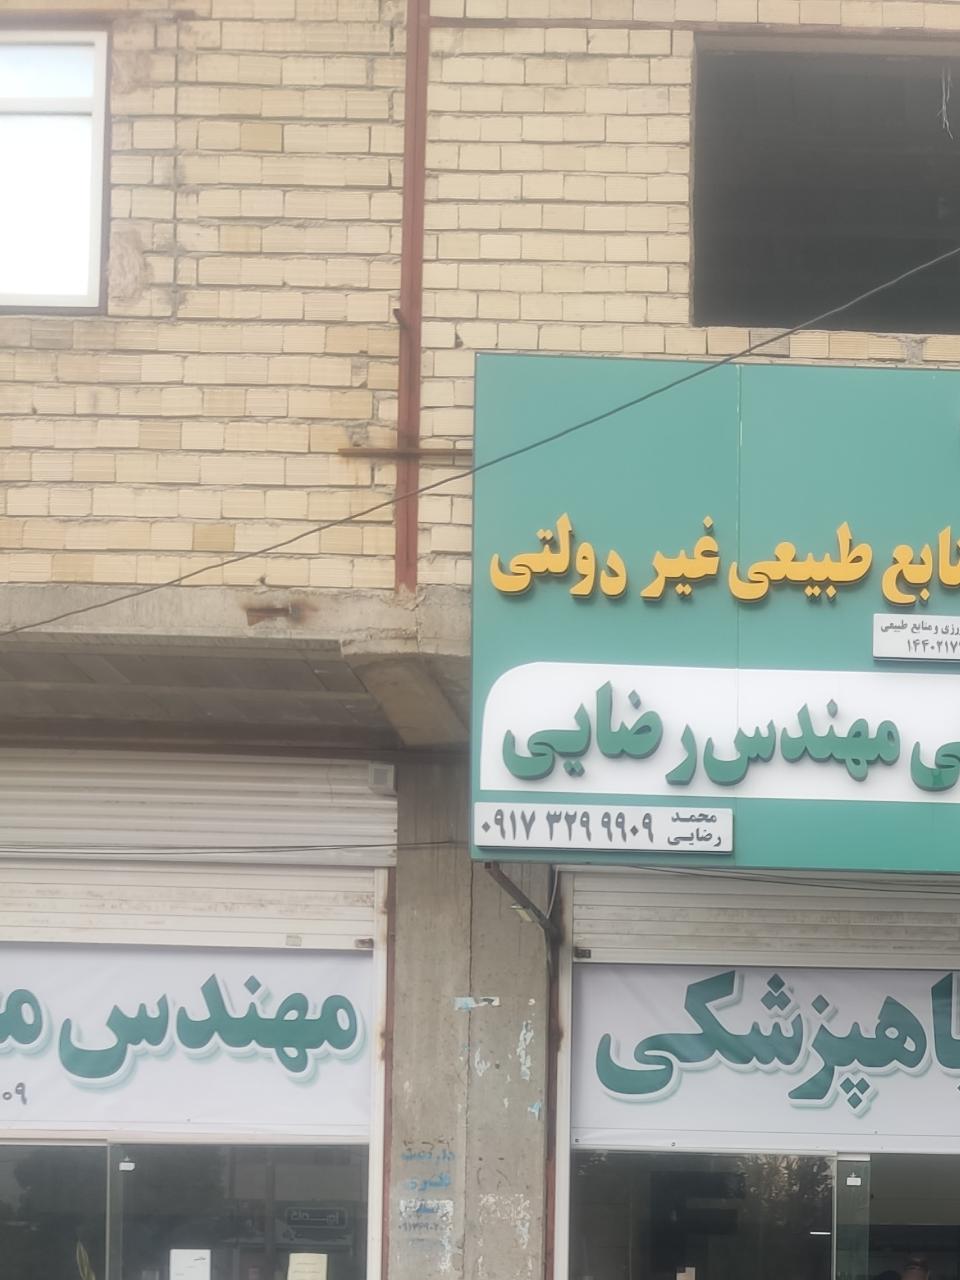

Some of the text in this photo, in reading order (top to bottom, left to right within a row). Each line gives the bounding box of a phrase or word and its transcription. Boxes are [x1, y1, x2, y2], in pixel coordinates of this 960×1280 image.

[489, 513, 628, 598] دولتی
[641, 516, 721, 600] غیر
[728, 522, 873, 602] طبیعی
[880, 620, 908, 633] طبیعی
[910, 622, 933, 635] منابع
[501, 681, 697, 786] رضایی
[702, 699, 901, 786] مهندس
[481, 808, 655, 844] ۰۹۱۷ ۳۲۹ ۹۹۰۹
[667, 827, 722, 847] رضایی
[671, 811, 718, 823] محمد
[59, 973, 358, 1079] مهندس
